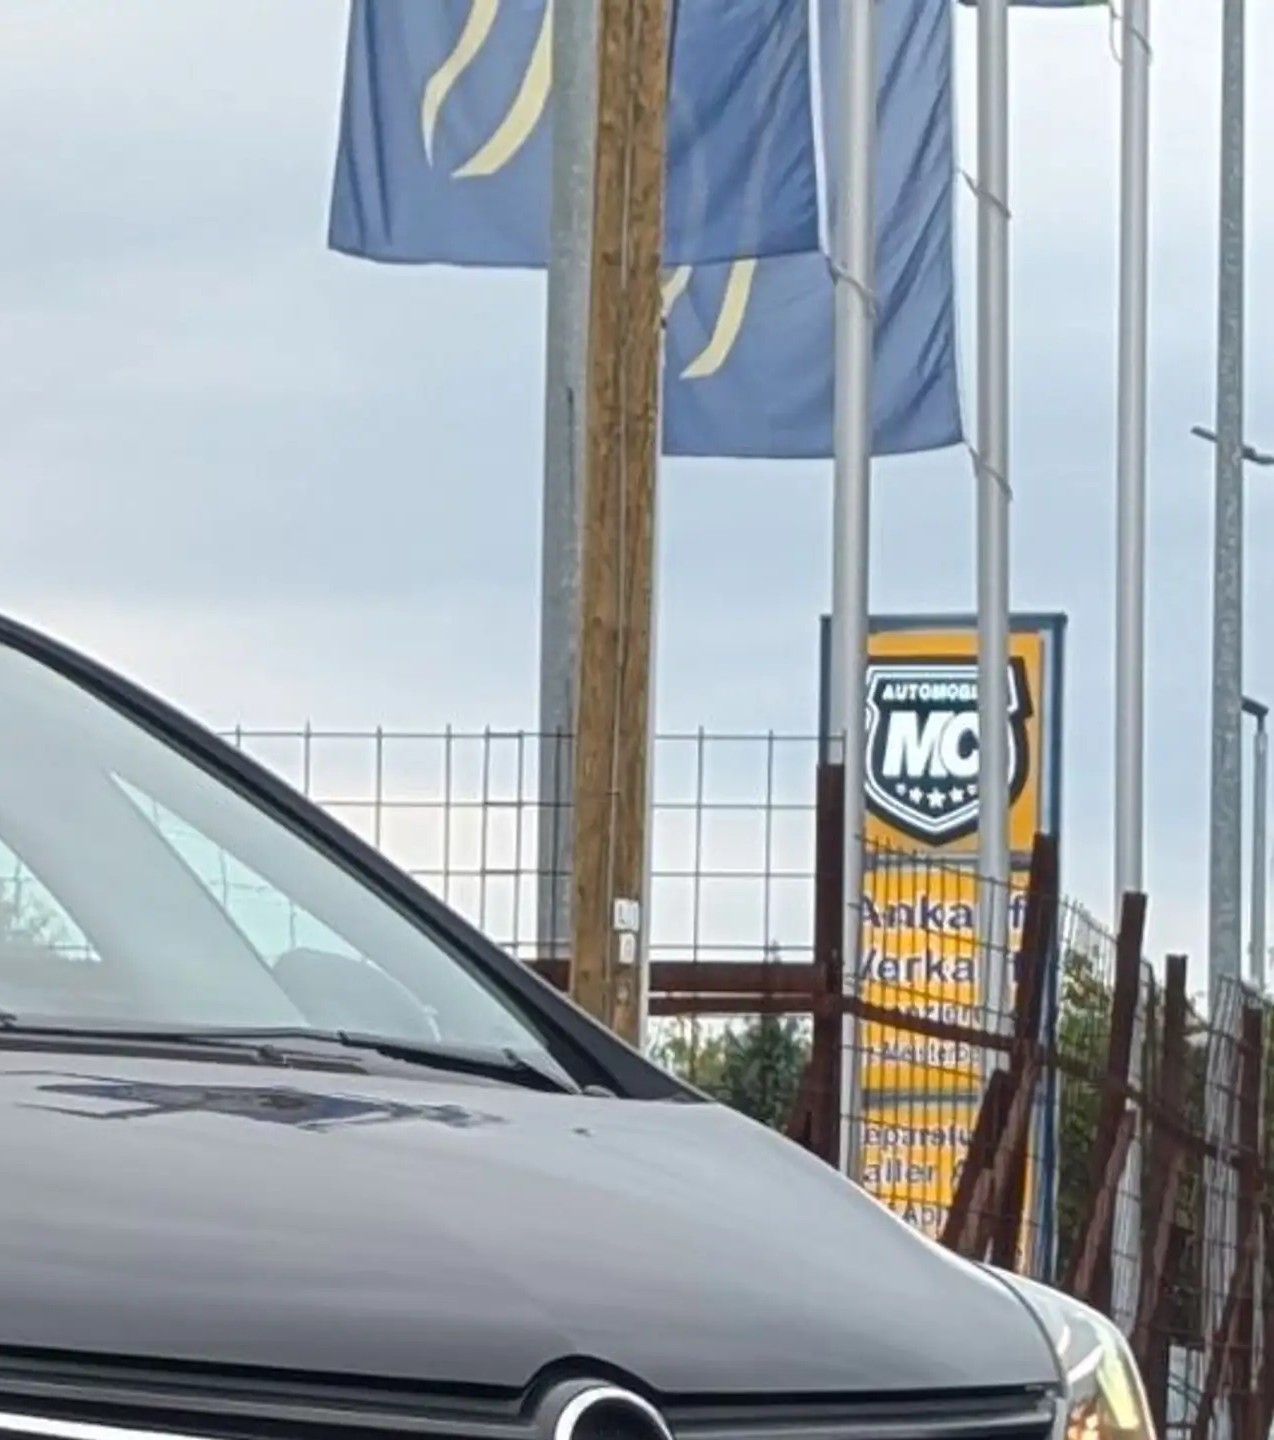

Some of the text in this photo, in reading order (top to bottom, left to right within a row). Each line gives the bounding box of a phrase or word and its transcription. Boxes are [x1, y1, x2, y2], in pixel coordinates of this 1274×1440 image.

[882, 683, 979, 701] AUTOMOBI
[882, 711, 980, 779] MC
[860, 892, 1027, 929] Ankaf
